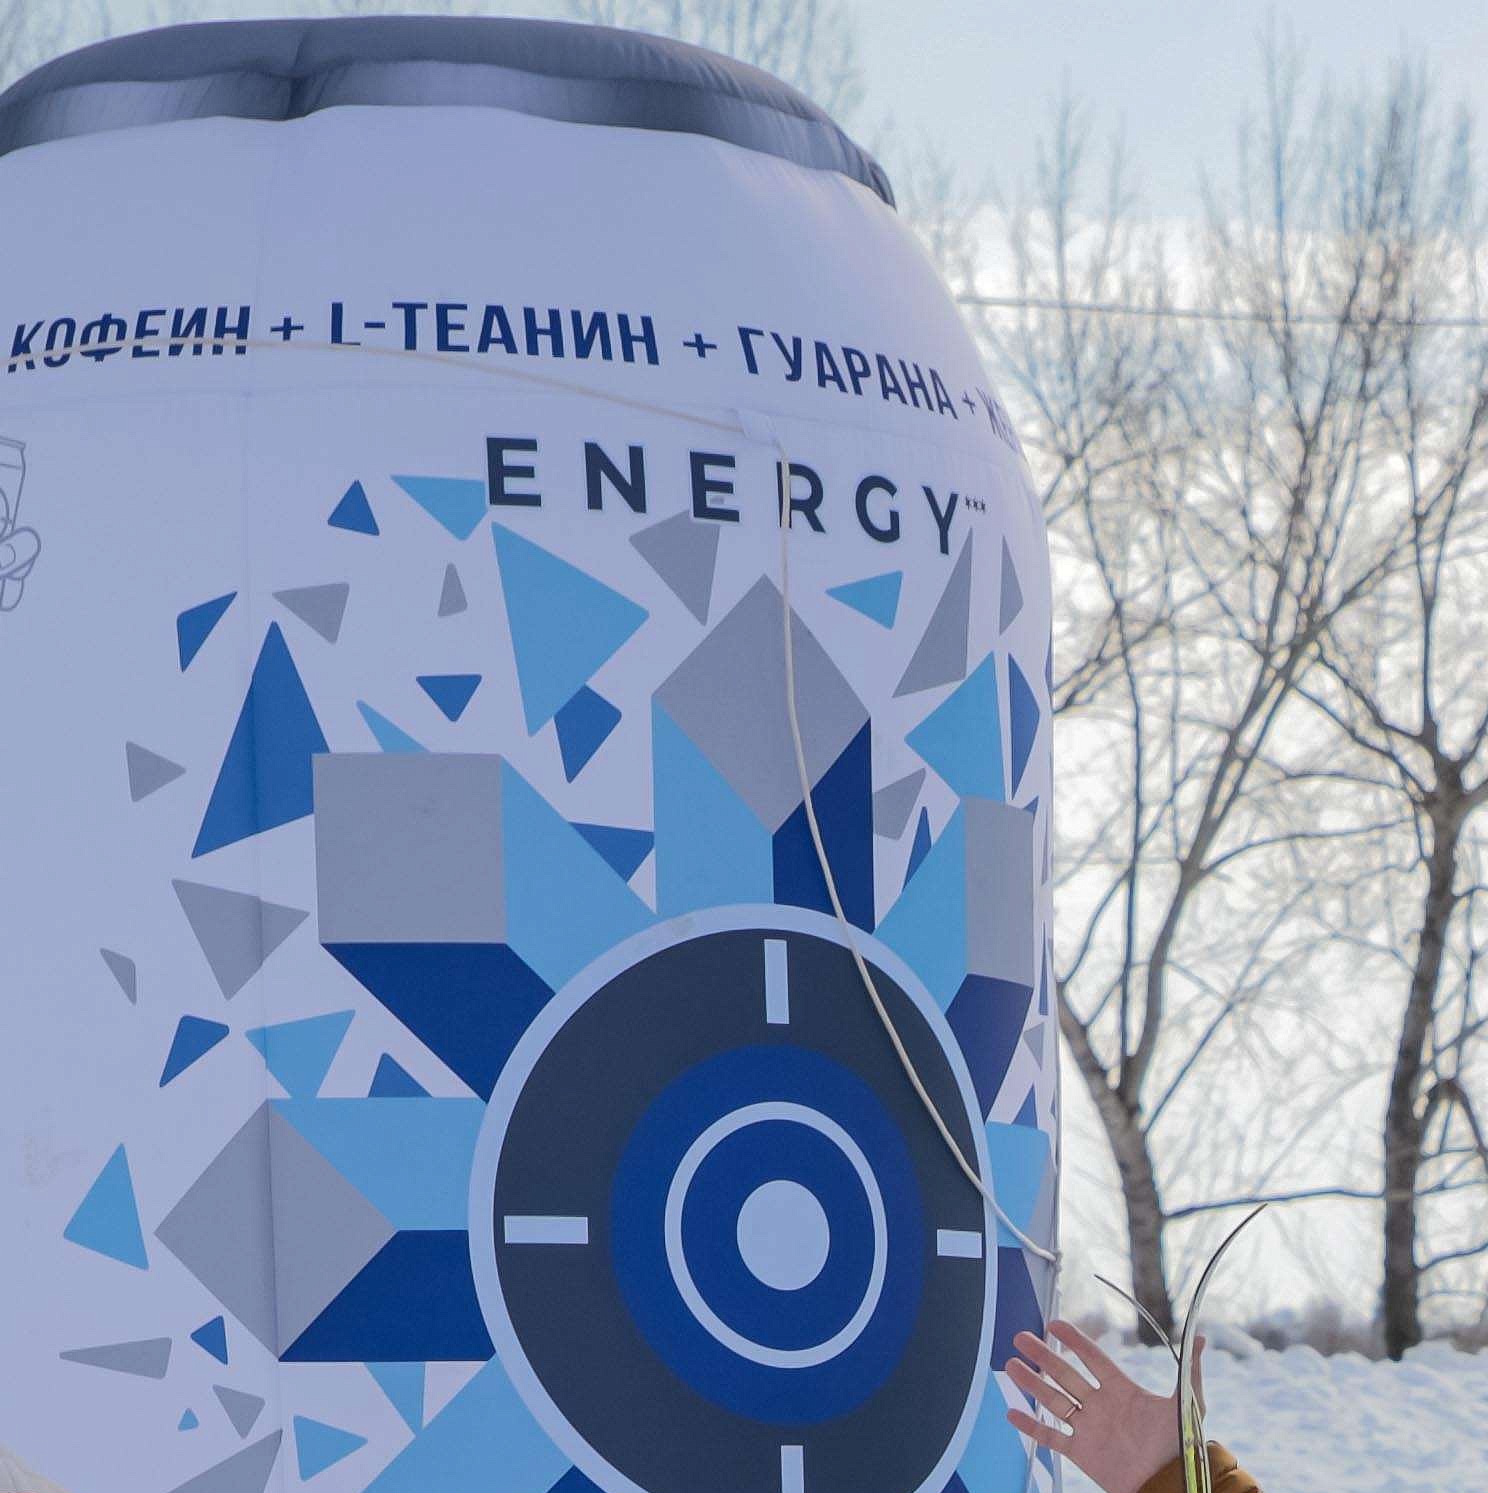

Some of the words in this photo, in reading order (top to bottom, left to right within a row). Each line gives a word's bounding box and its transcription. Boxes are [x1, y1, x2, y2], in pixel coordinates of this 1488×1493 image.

[8, 306, 250, 373] КОФЕИН
[330, 302, 660, 366] L-ТЕАНИН
[736, 326, 959, 420] ГУАРАНА
